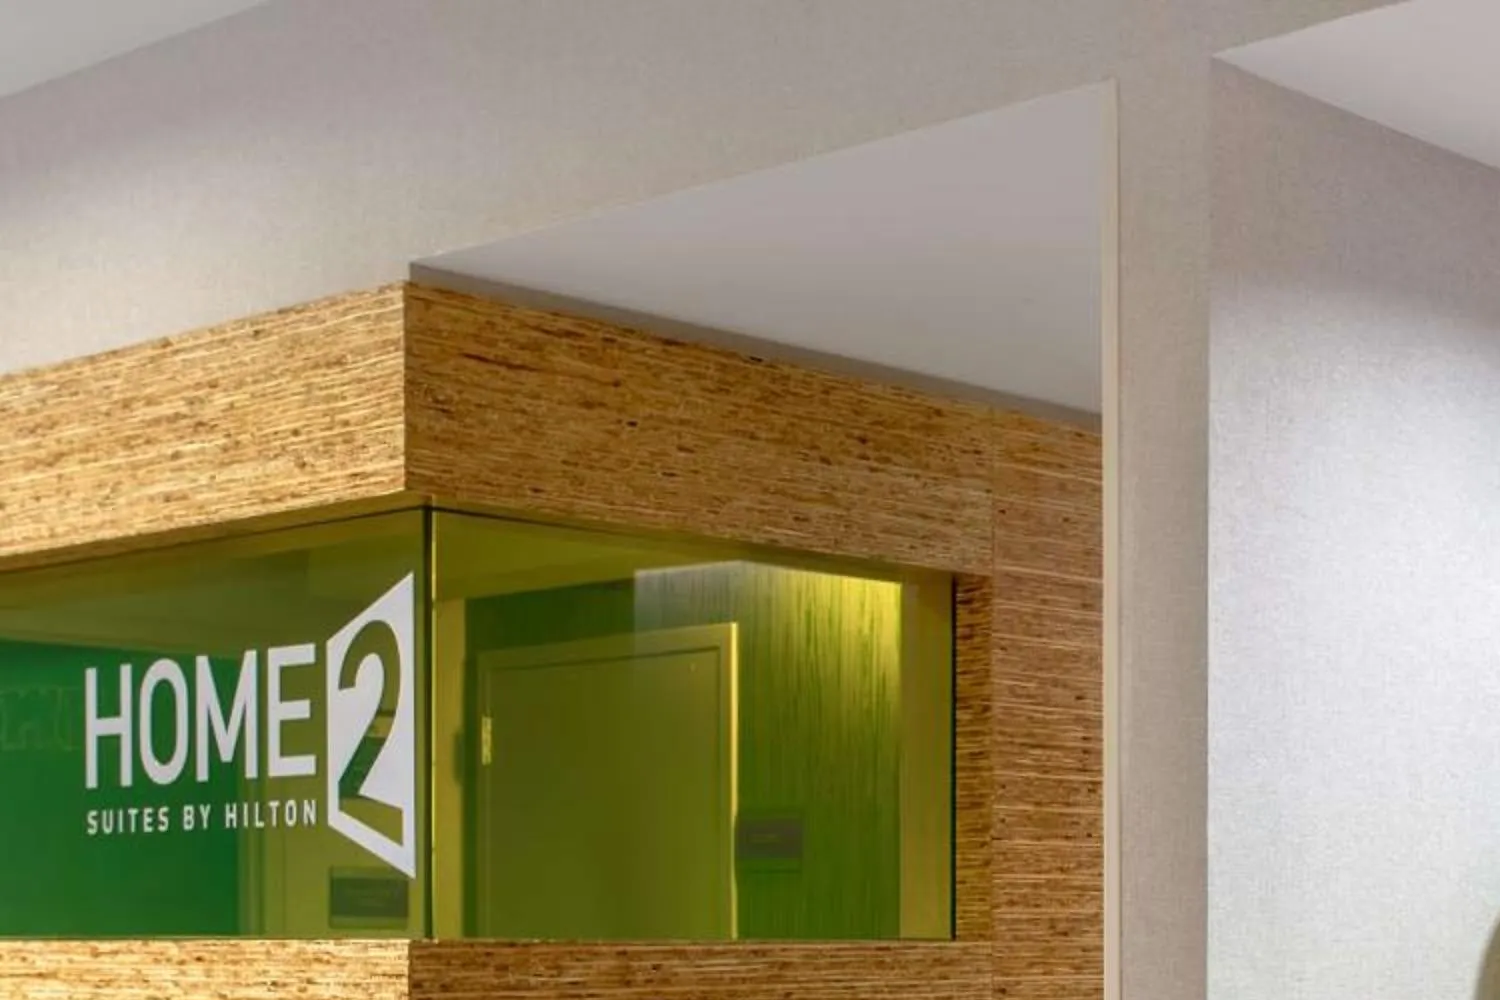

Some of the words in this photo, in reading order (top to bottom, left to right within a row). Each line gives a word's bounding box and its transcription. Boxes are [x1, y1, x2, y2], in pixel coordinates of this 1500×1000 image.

[85, 643, 317, 789] HOME
[335, 613, 407, 853] 2
[86, 805, 170, 836] SUITES
[183, 804, 212, 830] BY
[225, 799, 317, 828] HILTON
